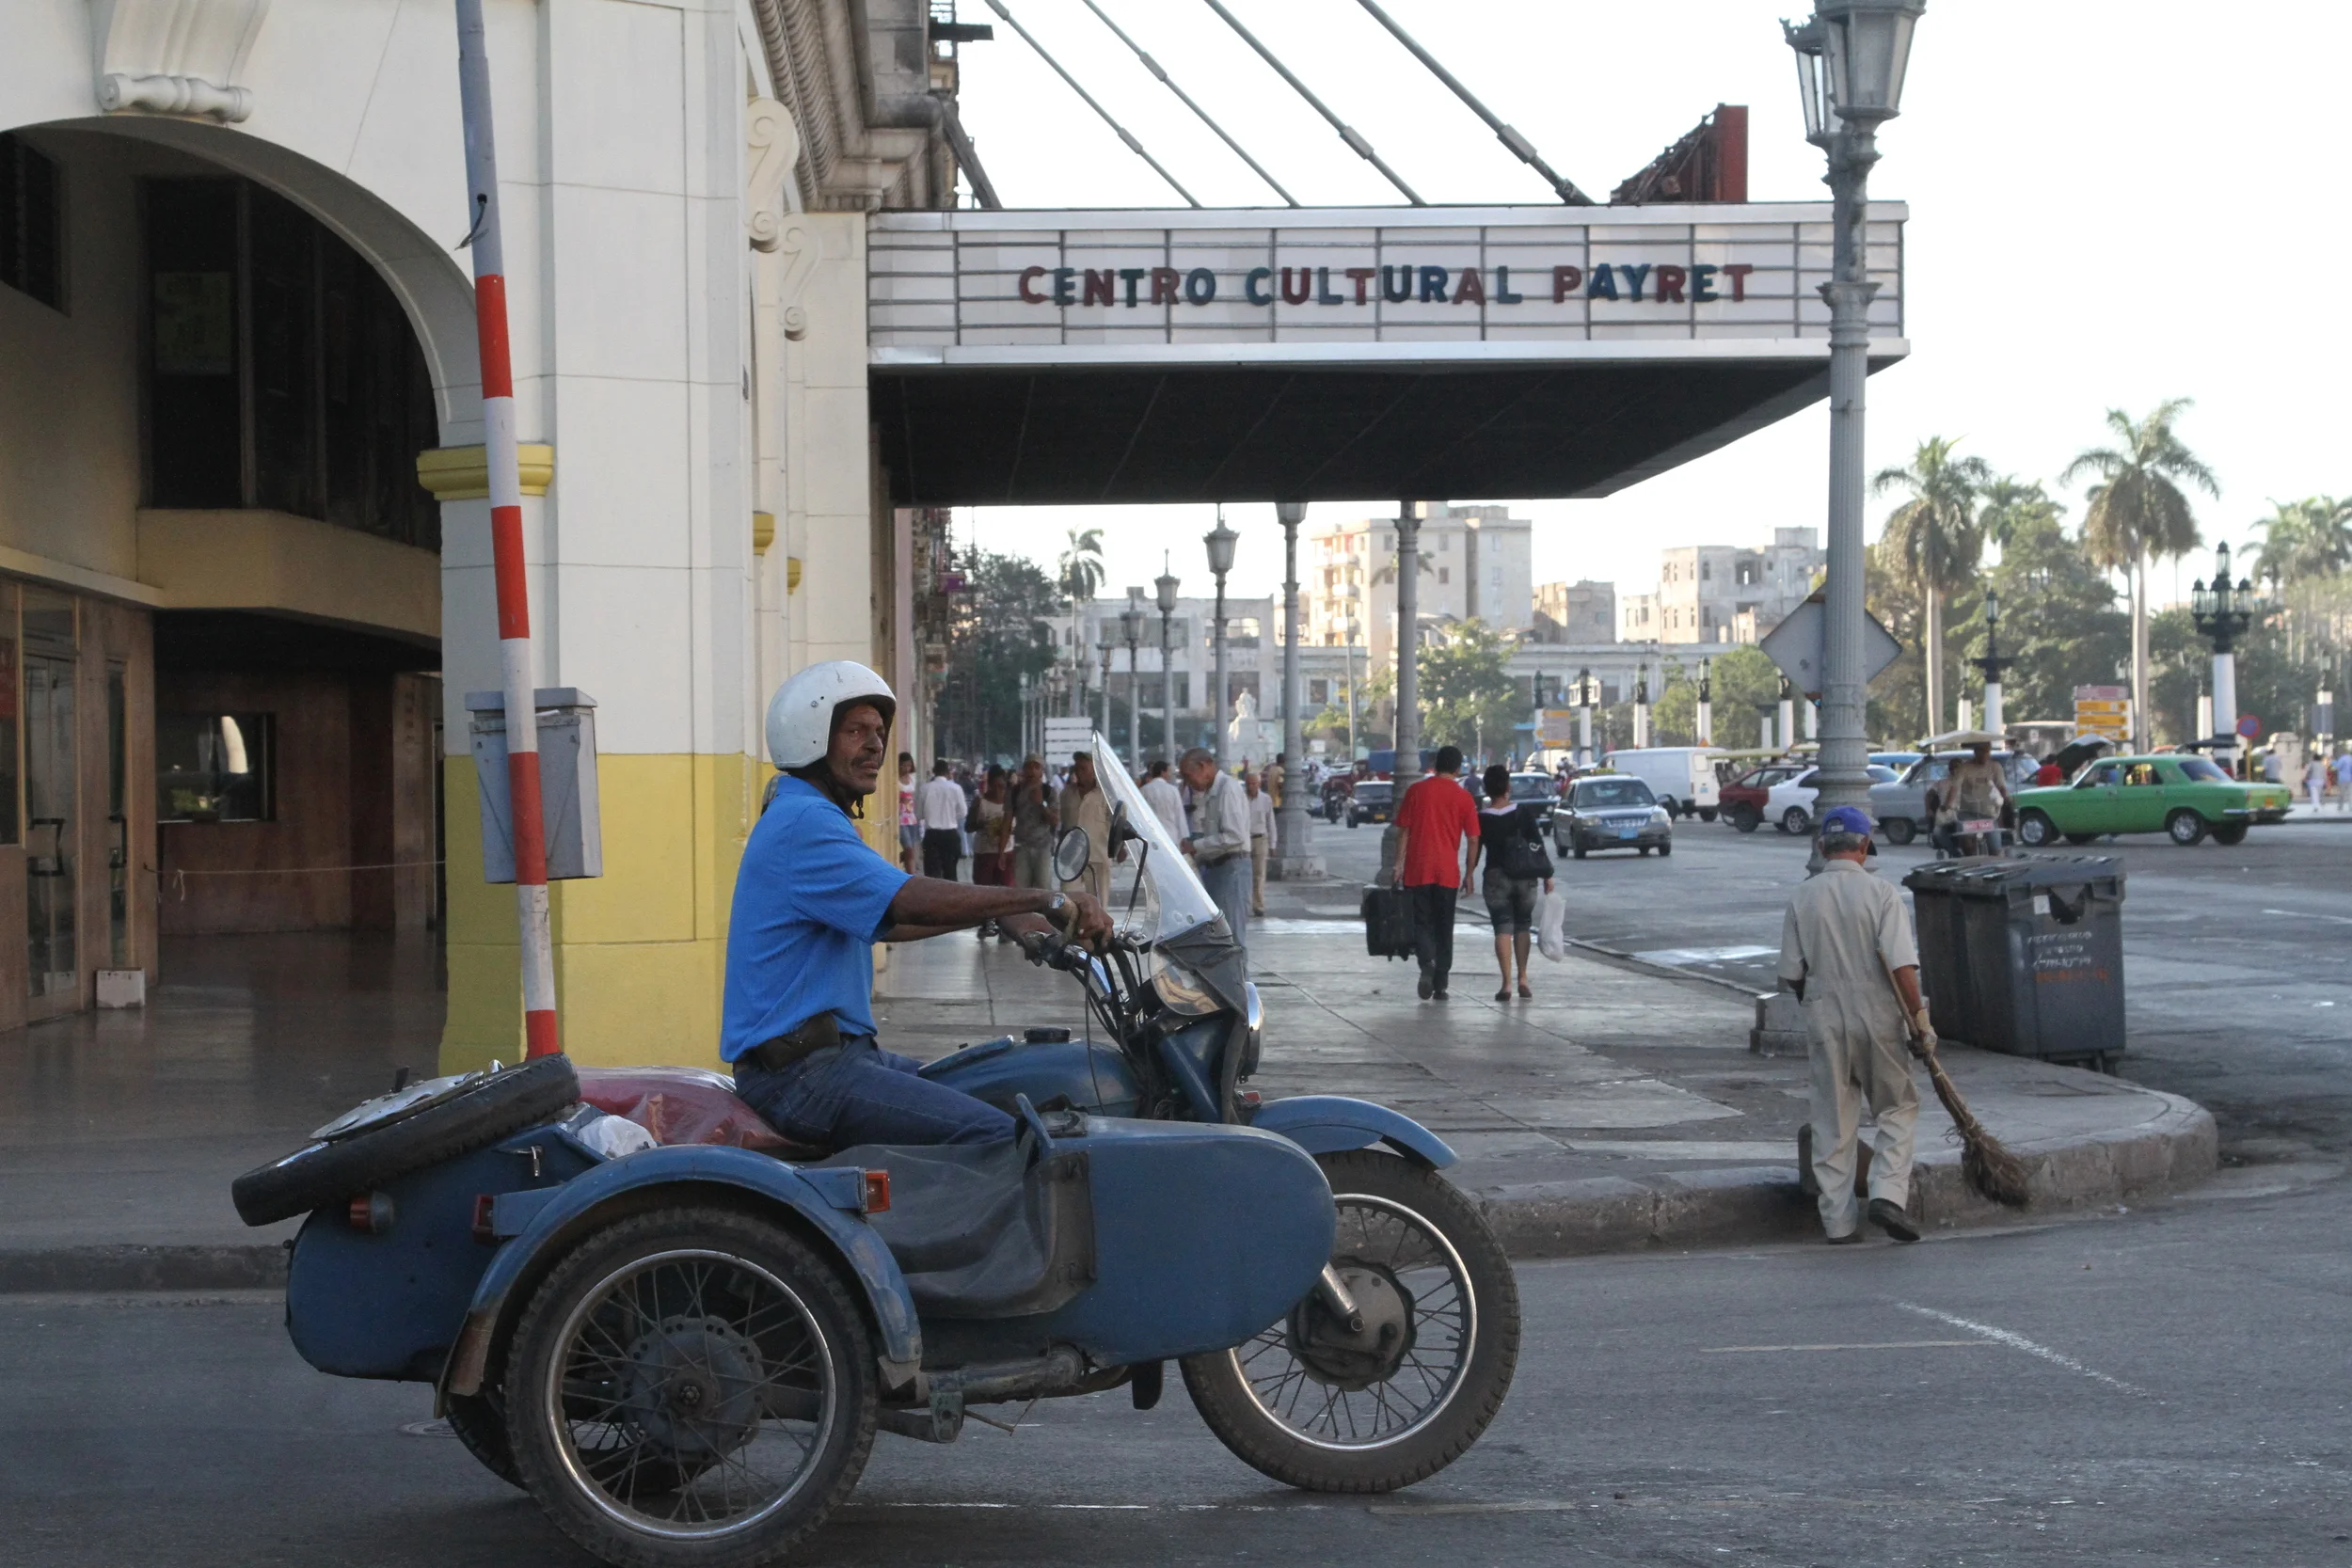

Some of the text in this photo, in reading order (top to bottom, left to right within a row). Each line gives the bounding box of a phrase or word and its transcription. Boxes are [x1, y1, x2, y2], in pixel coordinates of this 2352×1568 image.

[1019, 262, 1753, 308] CENTRO CULTURAL PAYRET
